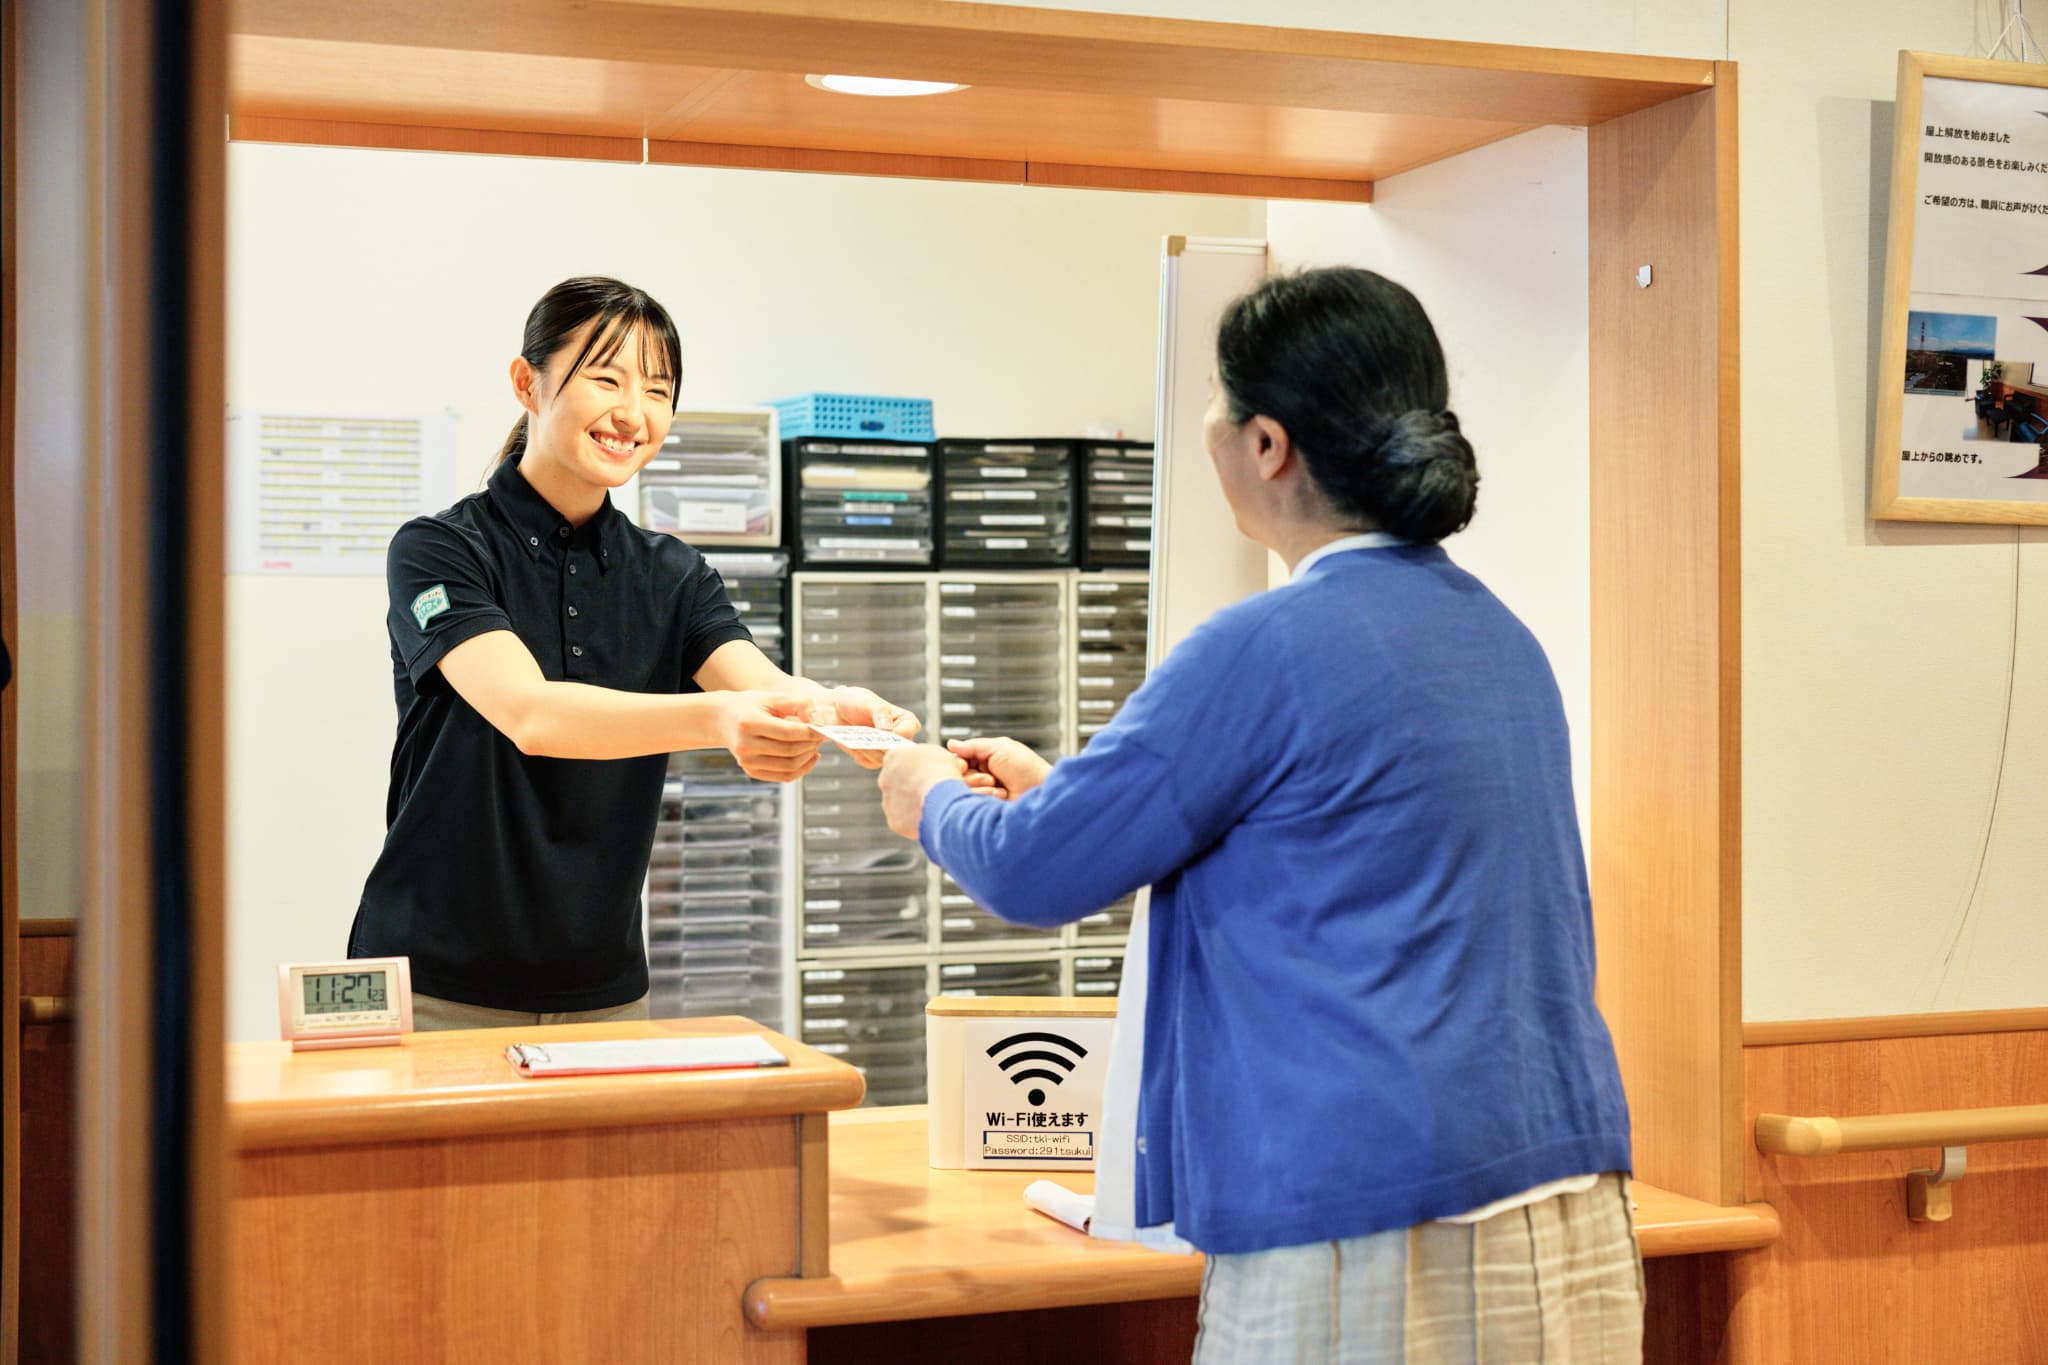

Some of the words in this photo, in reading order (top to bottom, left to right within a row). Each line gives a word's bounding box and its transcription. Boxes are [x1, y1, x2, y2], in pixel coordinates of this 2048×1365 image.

[1925, 125, 2011, 144] 屋上解放を始めました
[1901, 450, 1983, 465] 屋上からの眺めです。
[315, 974, 372, 1004] 11:27
[986, 1112, 1089, 1127] Wi-Fi使えます
